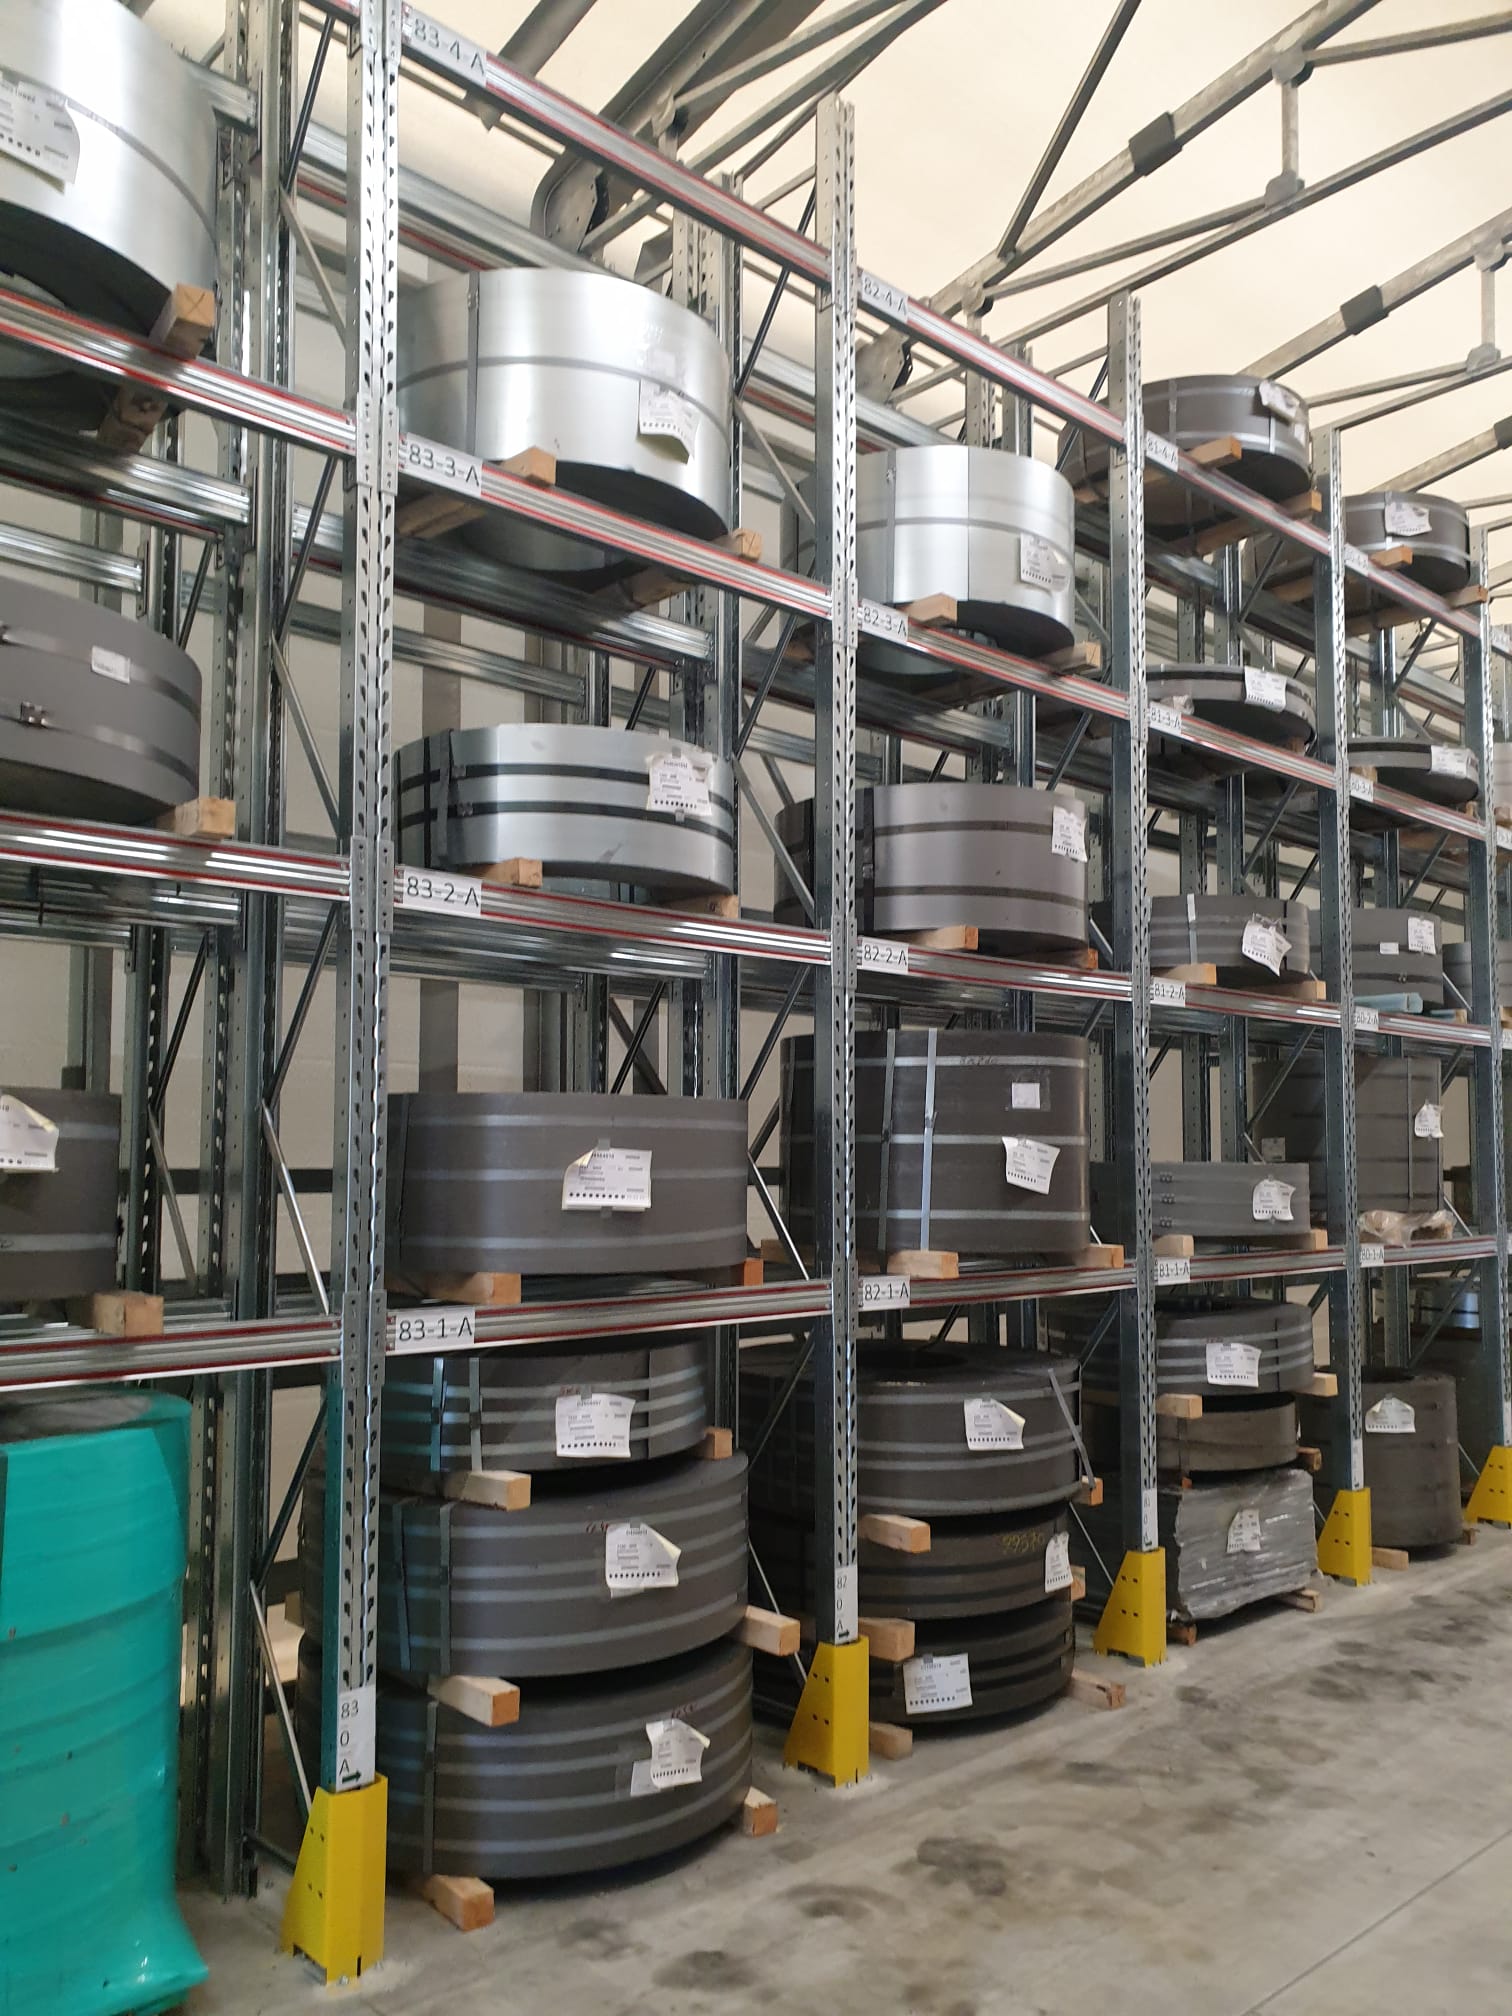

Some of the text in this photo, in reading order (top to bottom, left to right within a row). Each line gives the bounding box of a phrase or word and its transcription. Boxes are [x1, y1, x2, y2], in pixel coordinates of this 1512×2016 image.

[409, 443, 480, 487] 83-3-A
[863, 606, 907, 637] 82-3-A
[407, 876, 479, 908] 83-2-A
[864, 944, 907, 966] 82-2-A
[1154, 983, 1185, 1000] 81-2-A
[1159, 1261, 1190, 1278] 81-1-A
[864, 1282, 909, 1301] 82-1-A
[399, 1316, 472, 1341] 83-1-A
[341, 1699, 359, 1719] 83
[340, 1730, 350, 1747] 0
[339, 1758, 350, 1776] A
